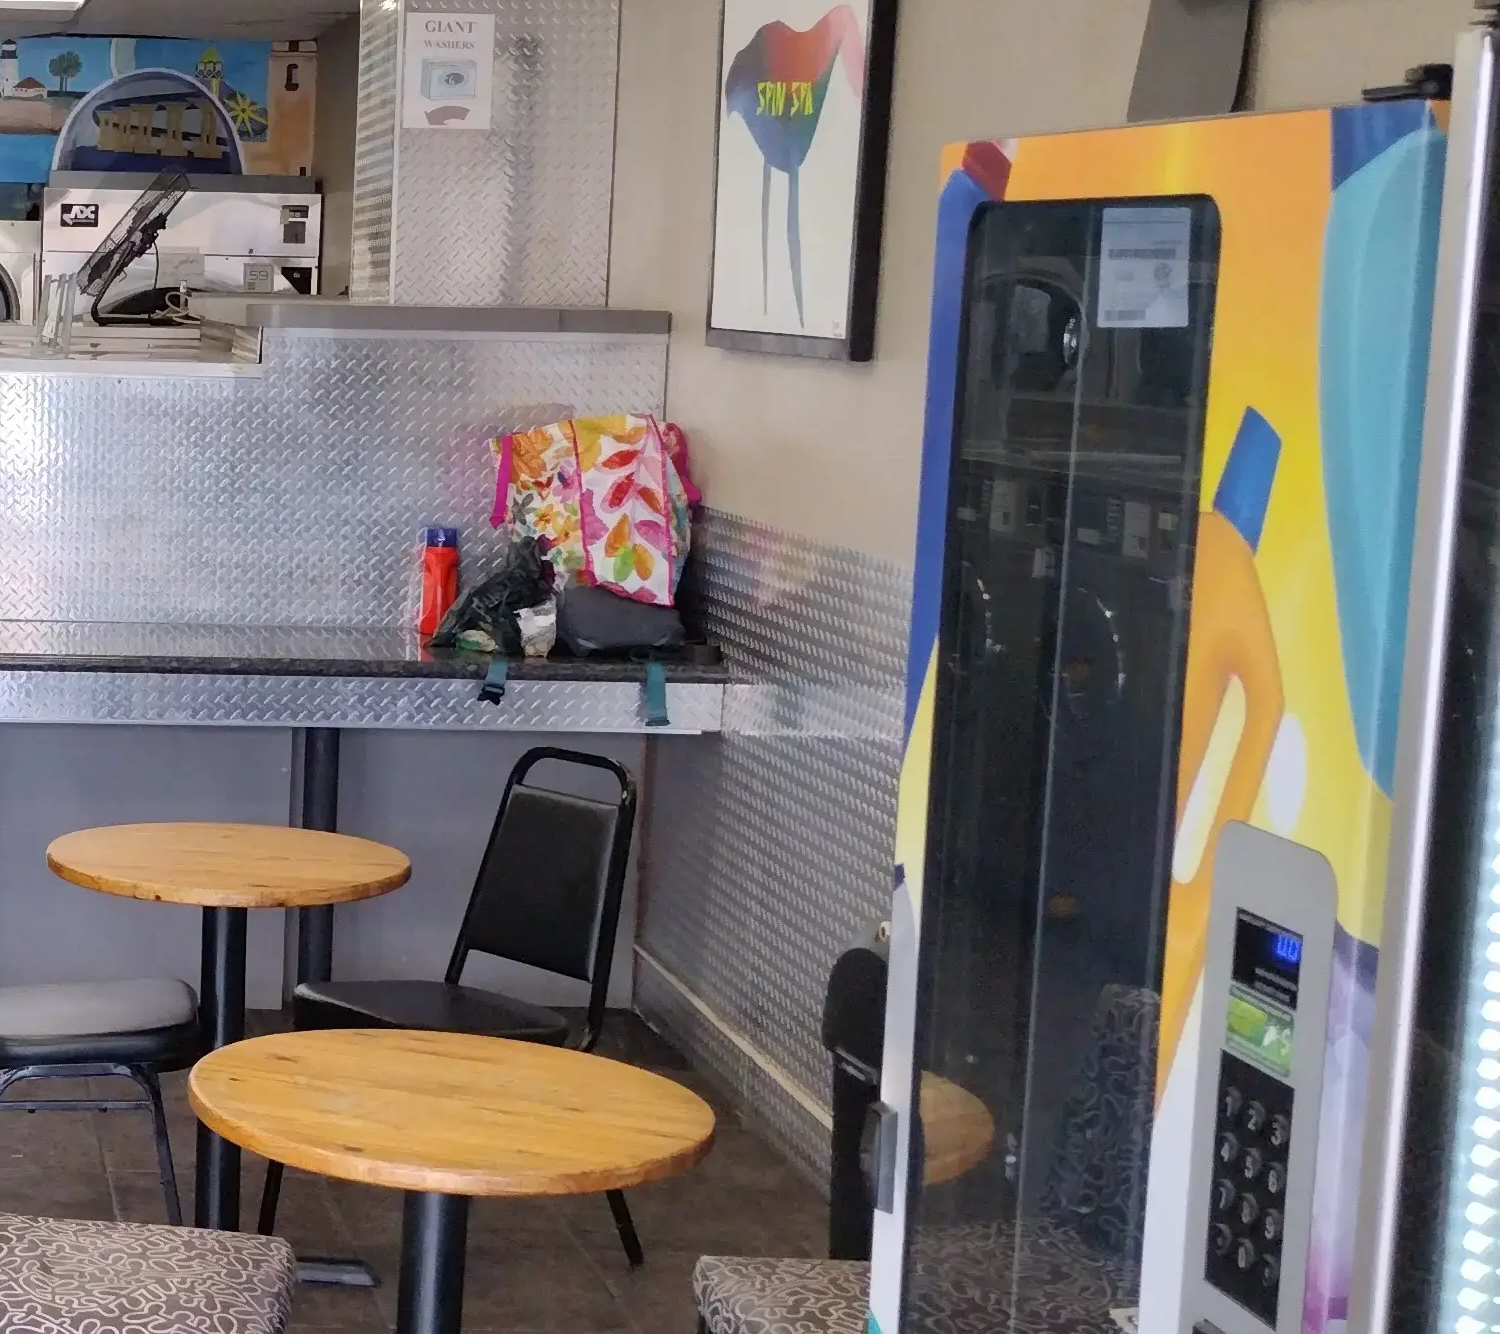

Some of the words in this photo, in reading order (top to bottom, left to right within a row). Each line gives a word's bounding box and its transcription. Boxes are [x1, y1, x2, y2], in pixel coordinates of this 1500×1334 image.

[424, 20, 477, 35] GIANT
[424, 40, 475, 51] WASHERS
[756, 80, 787, 116] SPIN
[790, 80, 813, 116] SPA
[70, 205, 96, 219] ADC
[1271, 1121, 1282, 1146] 3
